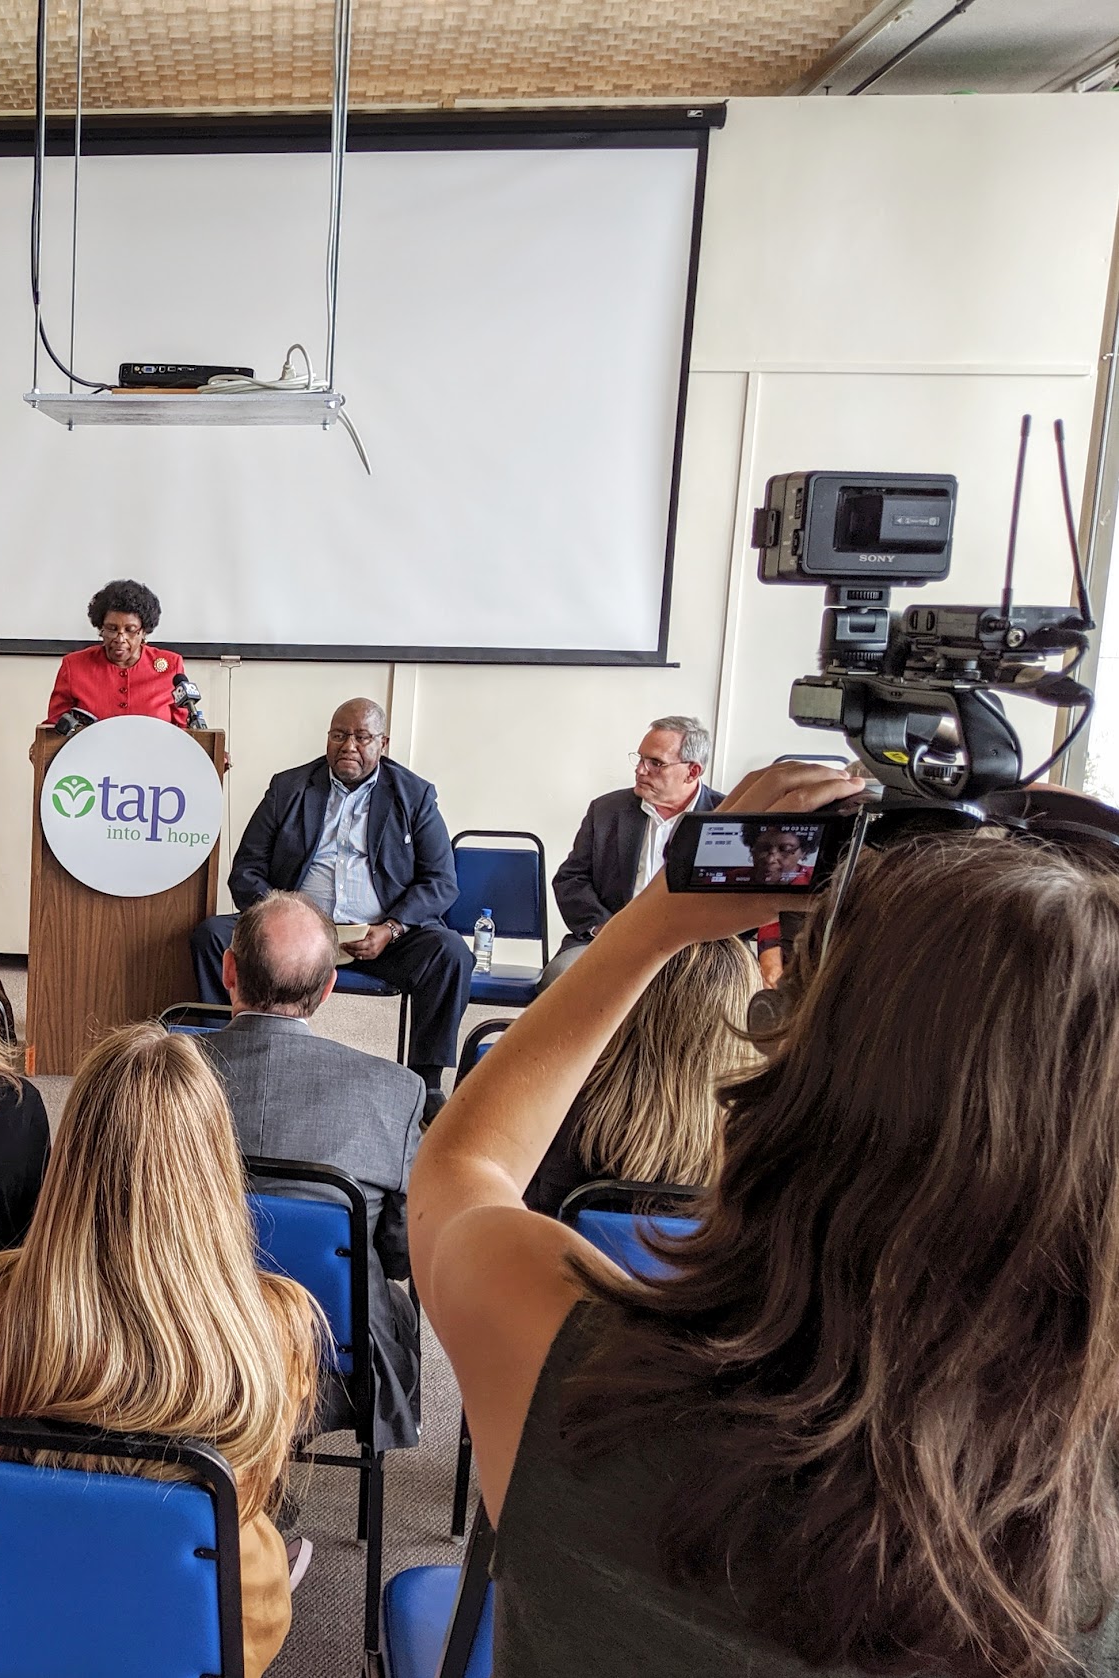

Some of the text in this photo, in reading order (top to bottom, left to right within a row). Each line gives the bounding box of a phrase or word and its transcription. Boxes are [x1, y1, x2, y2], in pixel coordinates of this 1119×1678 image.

[859, 554, 896, 563] SONY
[98, 776, 186, 842] tap
[106, 825, 210, 847] into hope
